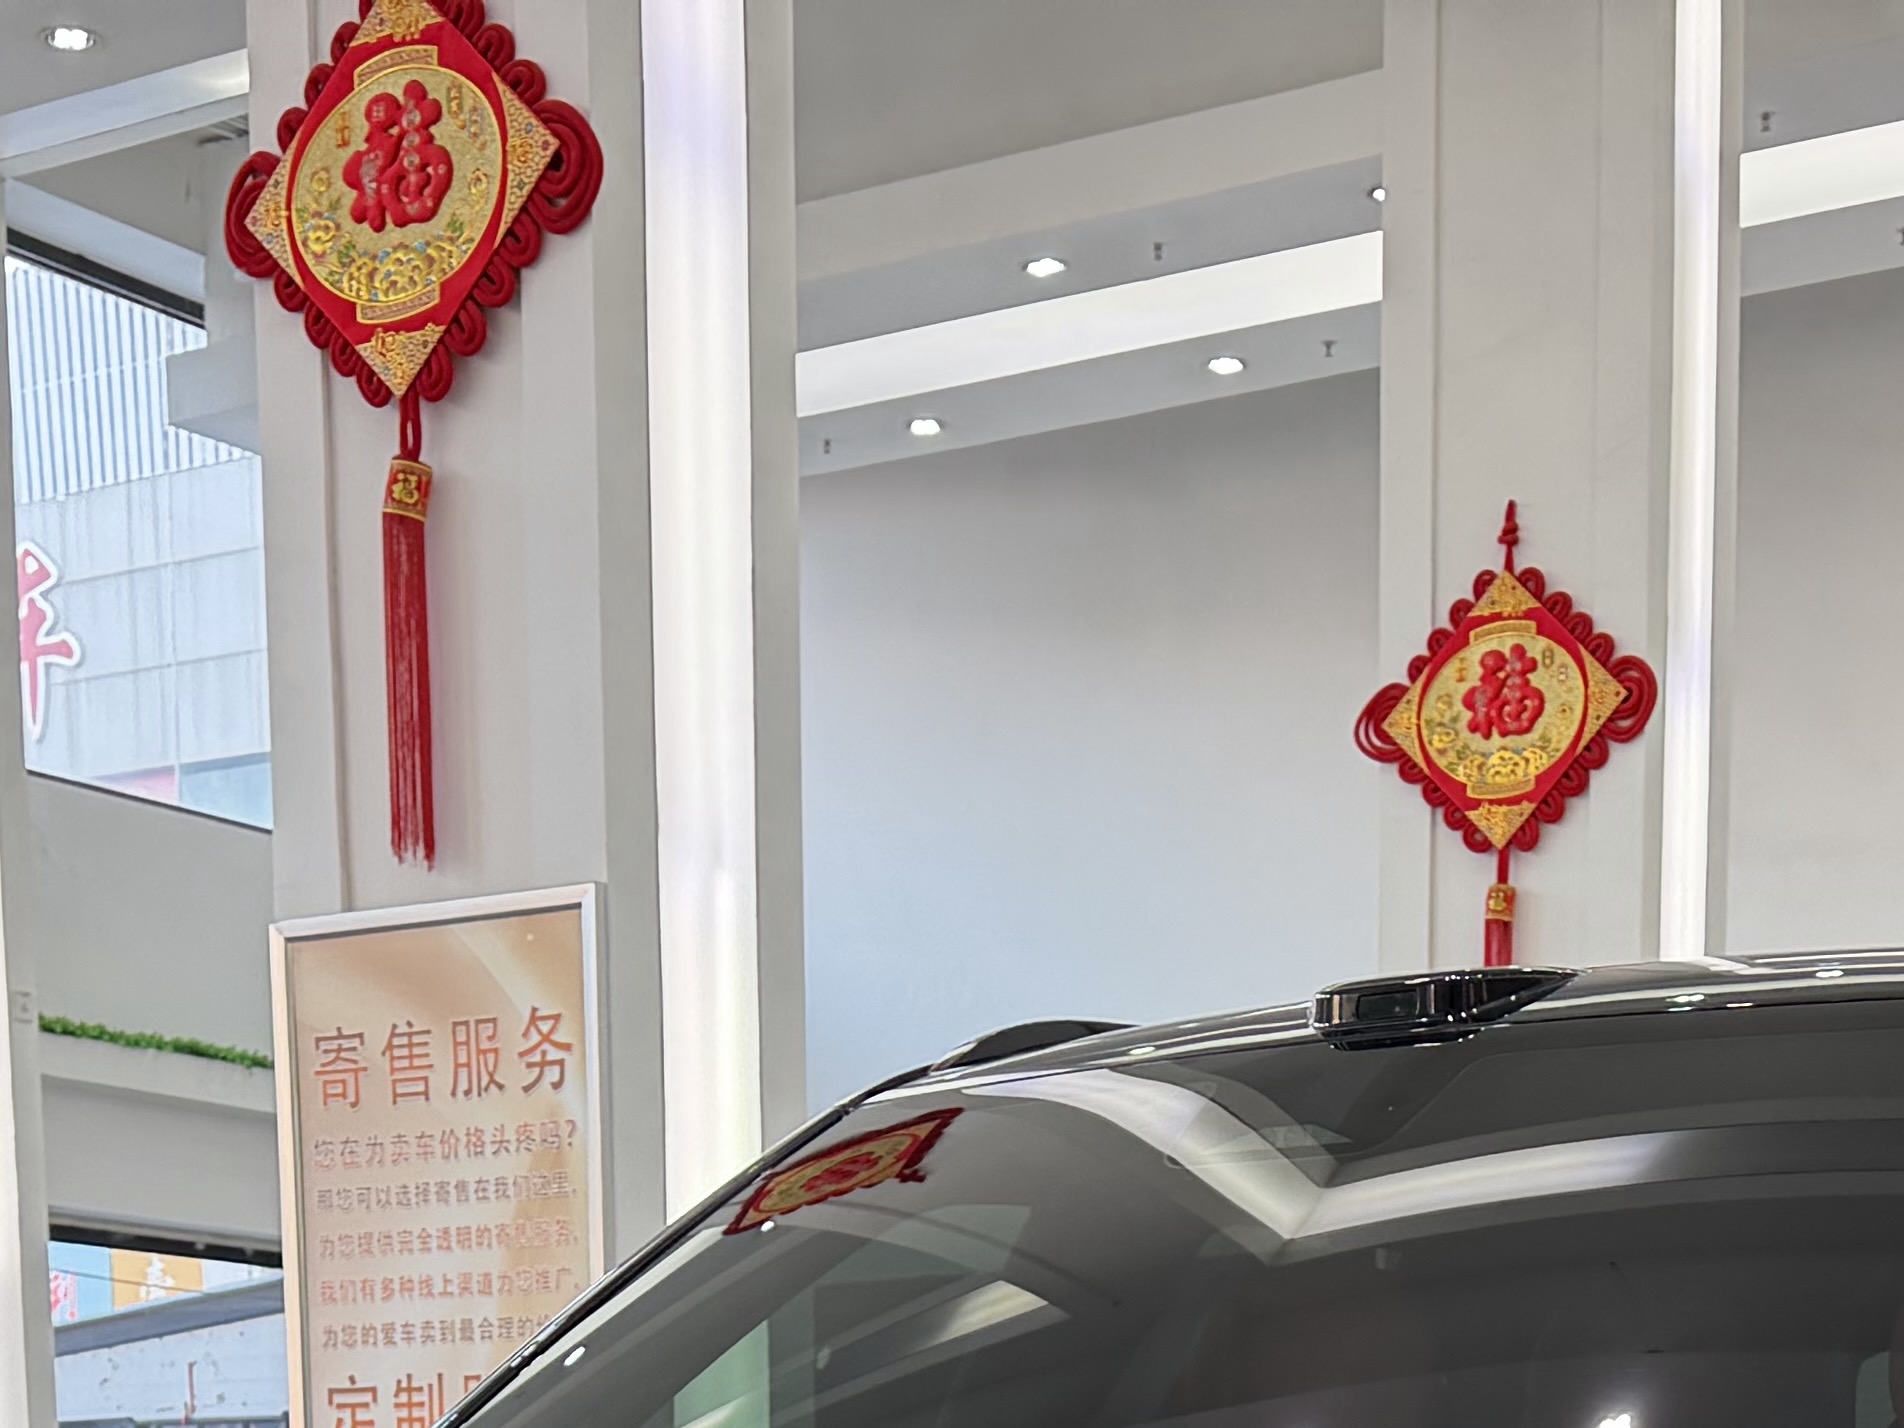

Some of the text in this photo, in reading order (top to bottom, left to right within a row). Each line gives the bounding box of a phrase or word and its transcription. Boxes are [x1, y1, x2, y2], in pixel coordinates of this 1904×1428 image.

[343, 80, 453, 233] 福
[1462, 643, 1545, 740] 福
[313, 1006, 574, 1110] 寄售服务
